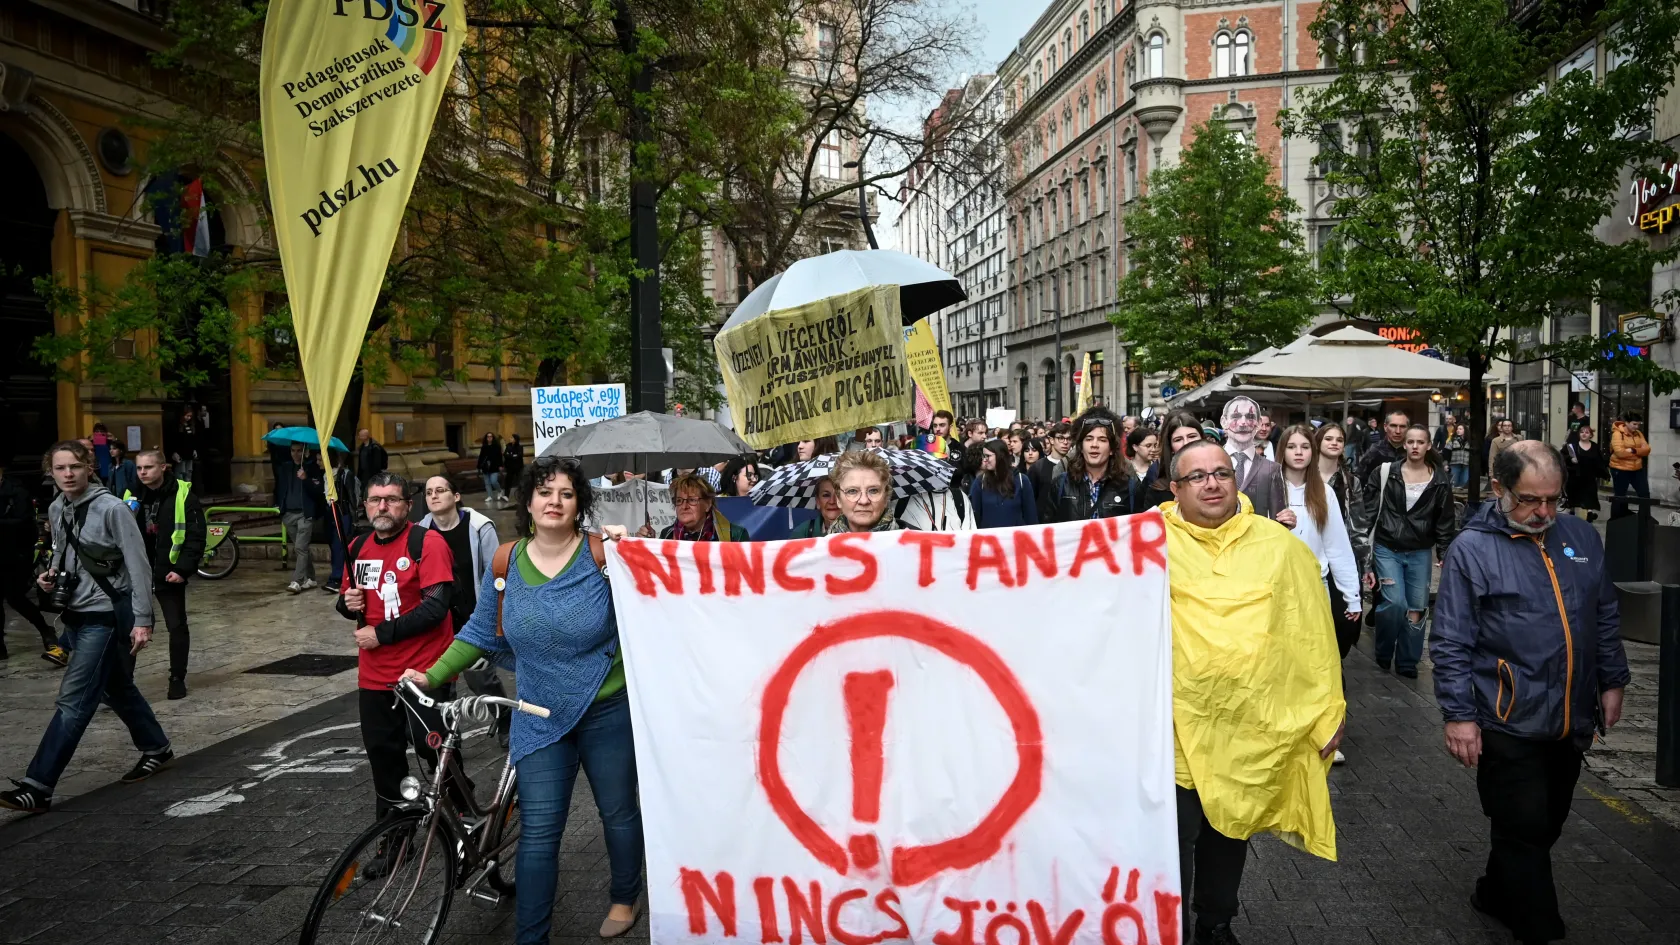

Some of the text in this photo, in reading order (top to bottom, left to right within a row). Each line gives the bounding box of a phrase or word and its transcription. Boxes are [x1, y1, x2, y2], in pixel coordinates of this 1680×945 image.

[282, 37, 391, 100] Pedagógusok
[294, 55, 406, 119] Demokratikus
[308, 71, 422, 138] Szakszervezete
[300, 157, 400, 238] pdsz.hu
[777, 307, 857, 353] VÉCEKRŐL
[866, 305, 875, 329] A
[537, 387, 620, 407] Budapest egy
[541, 402, 584, 419] szabad
[535, 421, 566, 439] Nem
[617, 531, 878, 597] NINCS
[678, 867, 908, 945] NINCS
